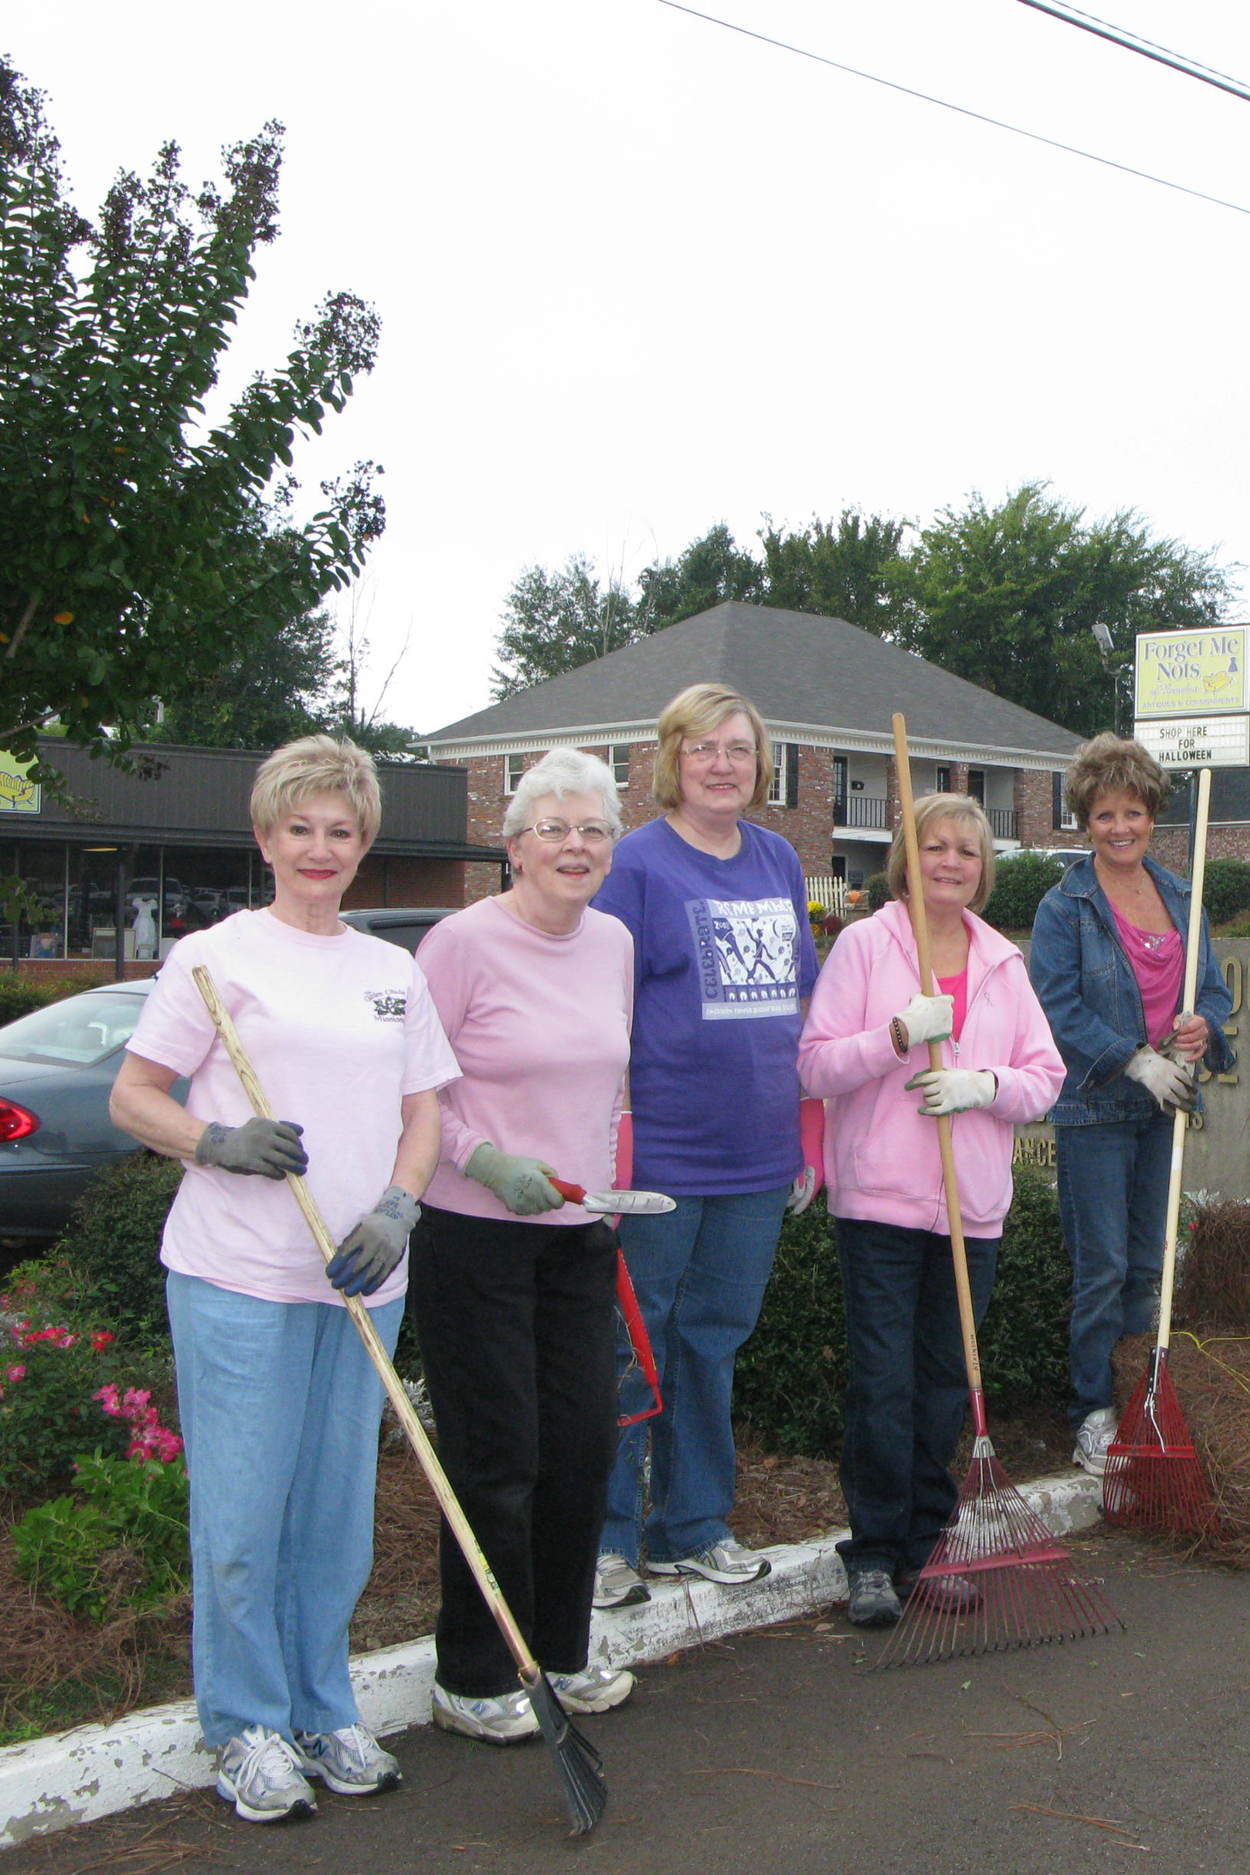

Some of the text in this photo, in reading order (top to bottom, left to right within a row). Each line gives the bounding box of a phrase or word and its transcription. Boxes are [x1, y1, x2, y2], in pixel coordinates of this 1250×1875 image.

[1144, 635, 1239, 663] Forget Me
[1157, 662, 1200, 681] Nots
[1160, 726, 1208, 739] SHOP HERE
[1178, 738, 1195, 749] FOR
[1158, 749, 1212, 762] HALLOWEEN
